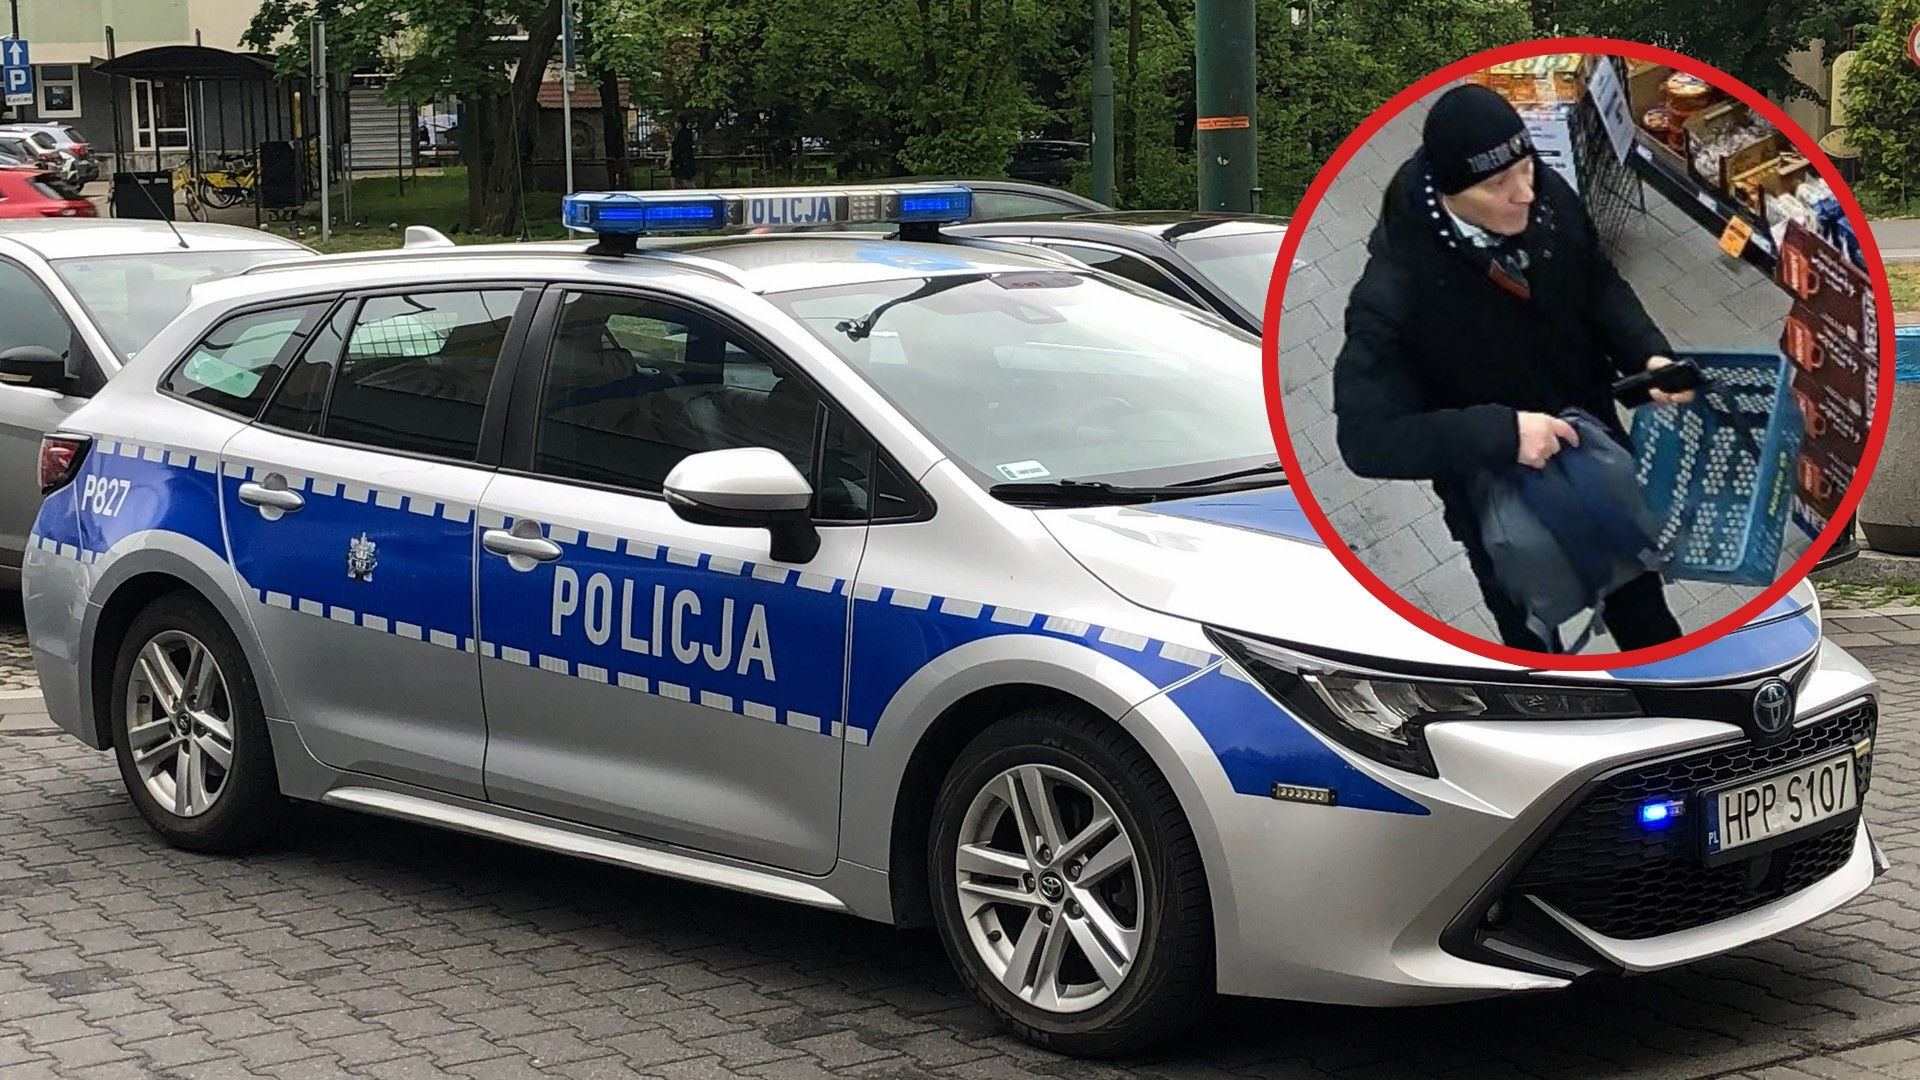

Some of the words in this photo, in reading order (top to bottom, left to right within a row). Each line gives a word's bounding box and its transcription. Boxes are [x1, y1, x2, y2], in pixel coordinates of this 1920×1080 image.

[10, 69, 26, 91] P
[746, 195, 832, 225] OLICJA
[80, 474, 131, 517] P827
[551, 565, 776, 682] POLICJA
[1725, 783, 1776, 845] HPP
[1787, 760, 1848, 822] S107
[1708, 830, 1719, 845] PL
